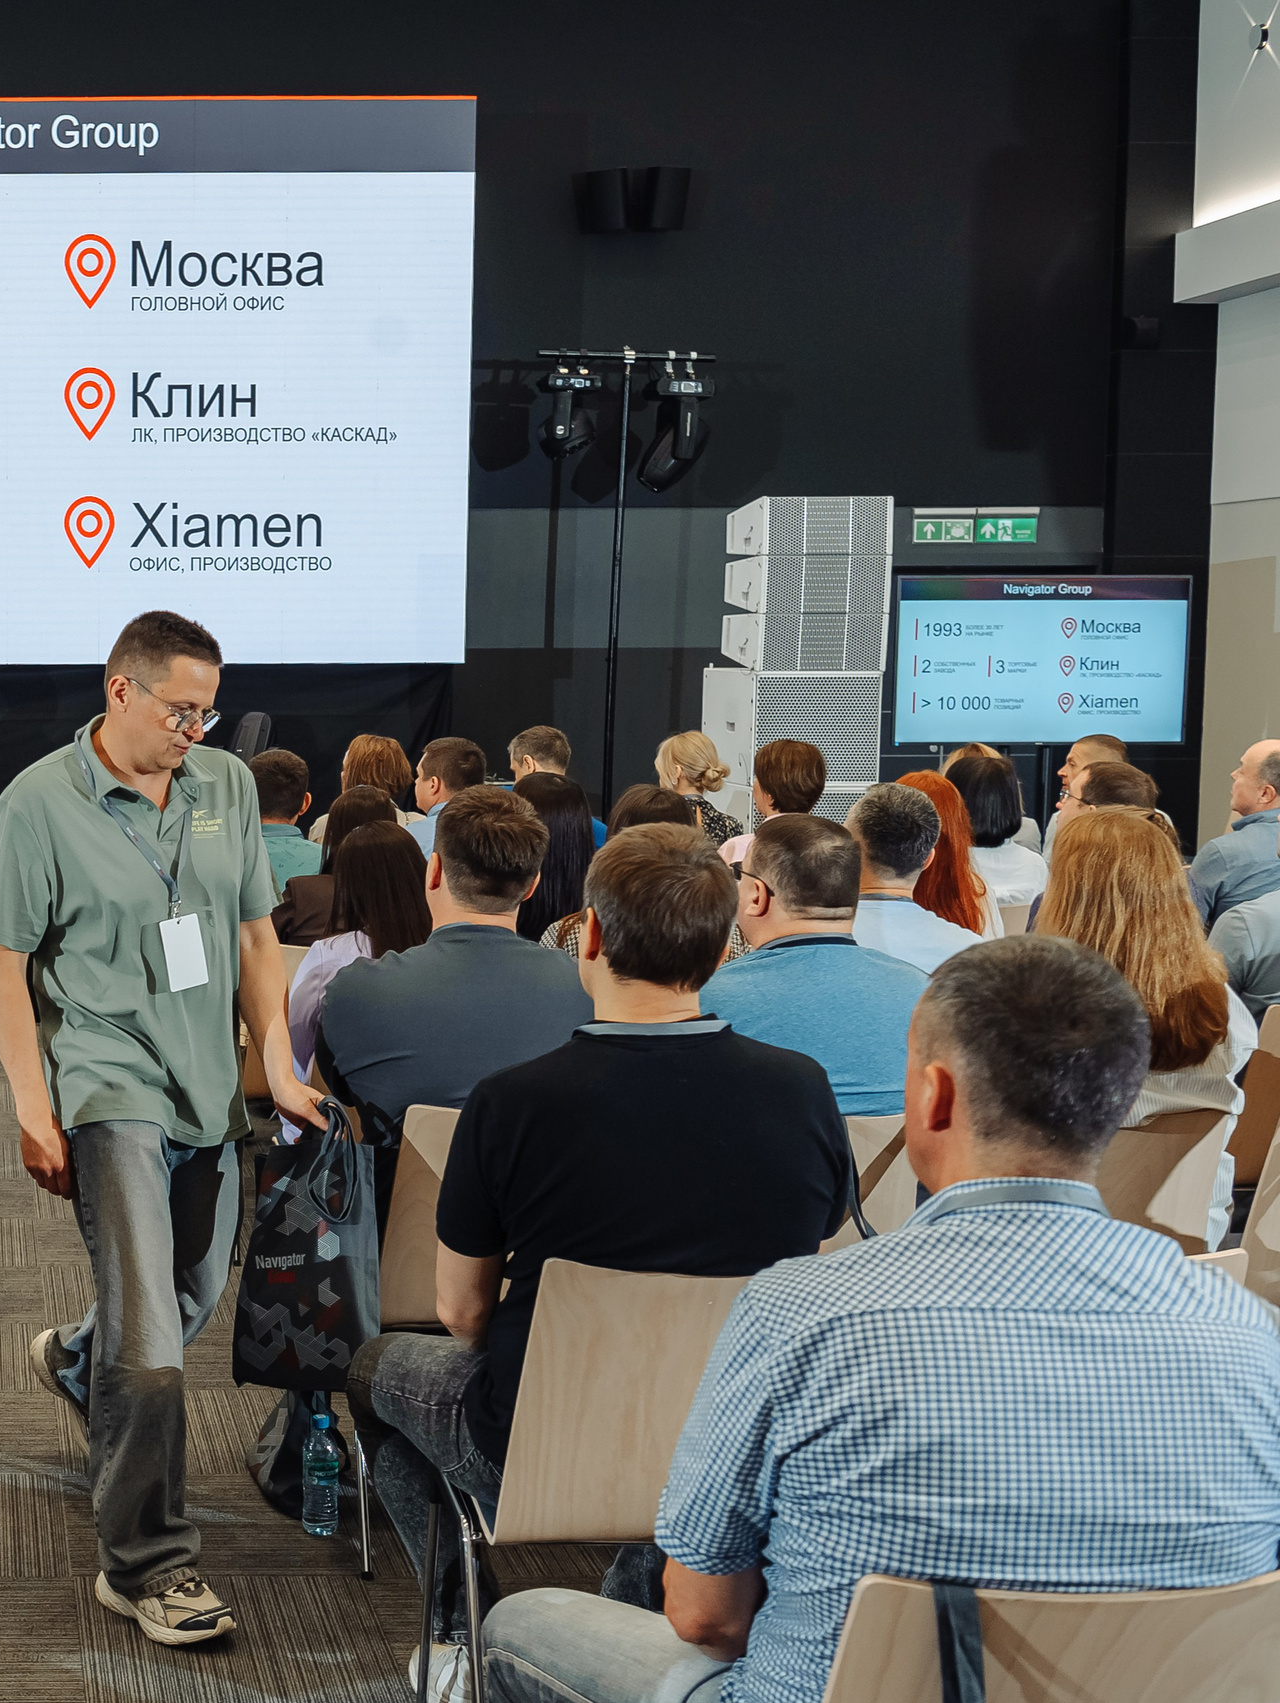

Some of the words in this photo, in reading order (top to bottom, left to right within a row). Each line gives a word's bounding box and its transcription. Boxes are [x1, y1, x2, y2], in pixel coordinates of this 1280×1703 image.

[52, 115, 158, 155] Group
[132, 241, 323, 287] Москва
[132, 293, 226, 311] ГОЛОВНОЙ
[233, 296, 284, 310] ОФИС
[132, 372, 256, 417] Клин
[132, 428, 157, 444] ЛК,
[164, 428, 305, 445] ПРОИЗВОДСТВО
[312, 427, 397, 444] «КАСКАД»
[131, 503, 321, 548] Xiamen
[130, 557, 184, 573] ОФИС,
[191, 557, 332, 574] ПРОИЗВОДСТВО
[1003, 583, 1056, 596] Navigator
[1058, 584, 1092, 597] Group
[923, 622, 962, 637] 1993
[1081, 619, 1141, 633] Москва
[921, 659, 931, 674] 2
[995, 660, 1005, 674] 3
[1079, 657, 1119, 671] Клин
[938, 696, 956, 711] 10
[961, 696, 991, 711] 000
[1078, 694, 1139, 708] Xiamen
[255, 1252, 306, 1270] Navigator
